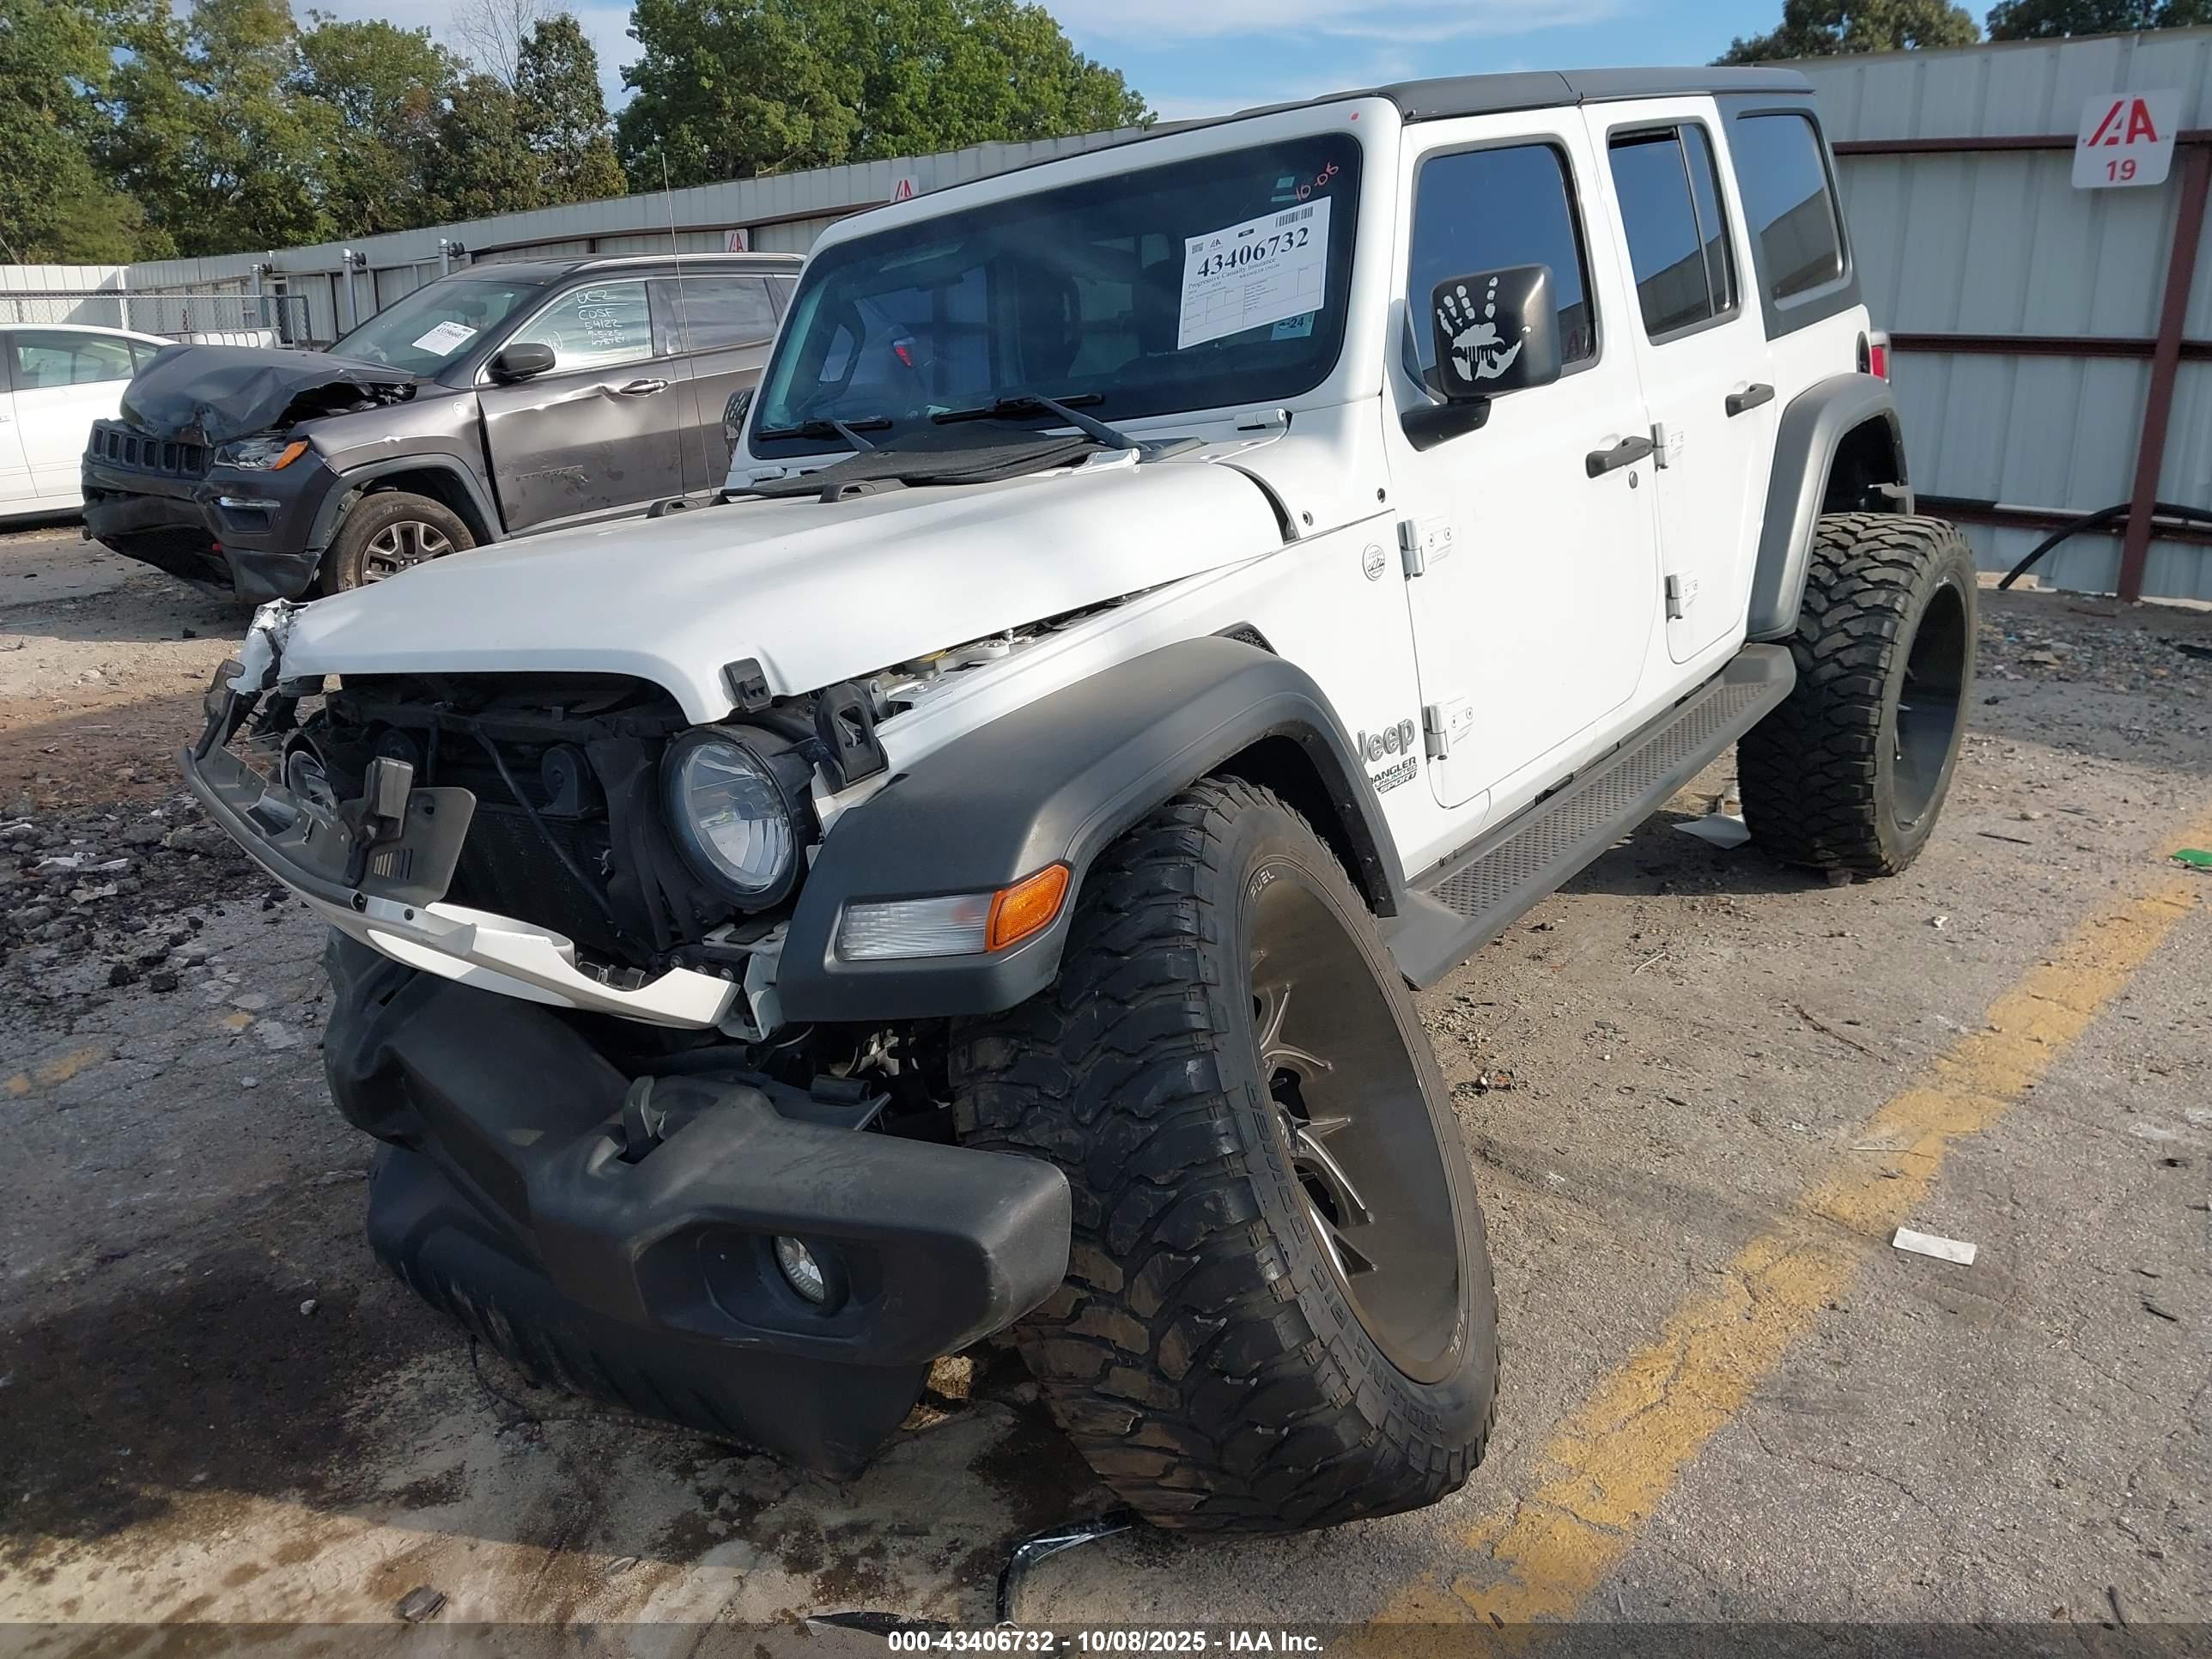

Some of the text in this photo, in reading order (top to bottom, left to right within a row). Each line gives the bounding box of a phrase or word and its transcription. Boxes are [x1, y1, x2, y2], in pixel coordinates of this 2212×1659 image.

[2106, 159, 2136, 181] 19
[1196, 227, 1310, 277] 43406732
[1188, 274, 1221, 289] Progressive
[1221, 264, 1247, 279] Casualty
[1248, 258, 1276, 270] Insurance
[1357, 718, 1415, 766] Jeep
[1374, 763, 1418, 788] UNLIMITED
[1249, 869, 1276, 902] FUEL
[1448, 1307, 1466, 1357] FUEL
